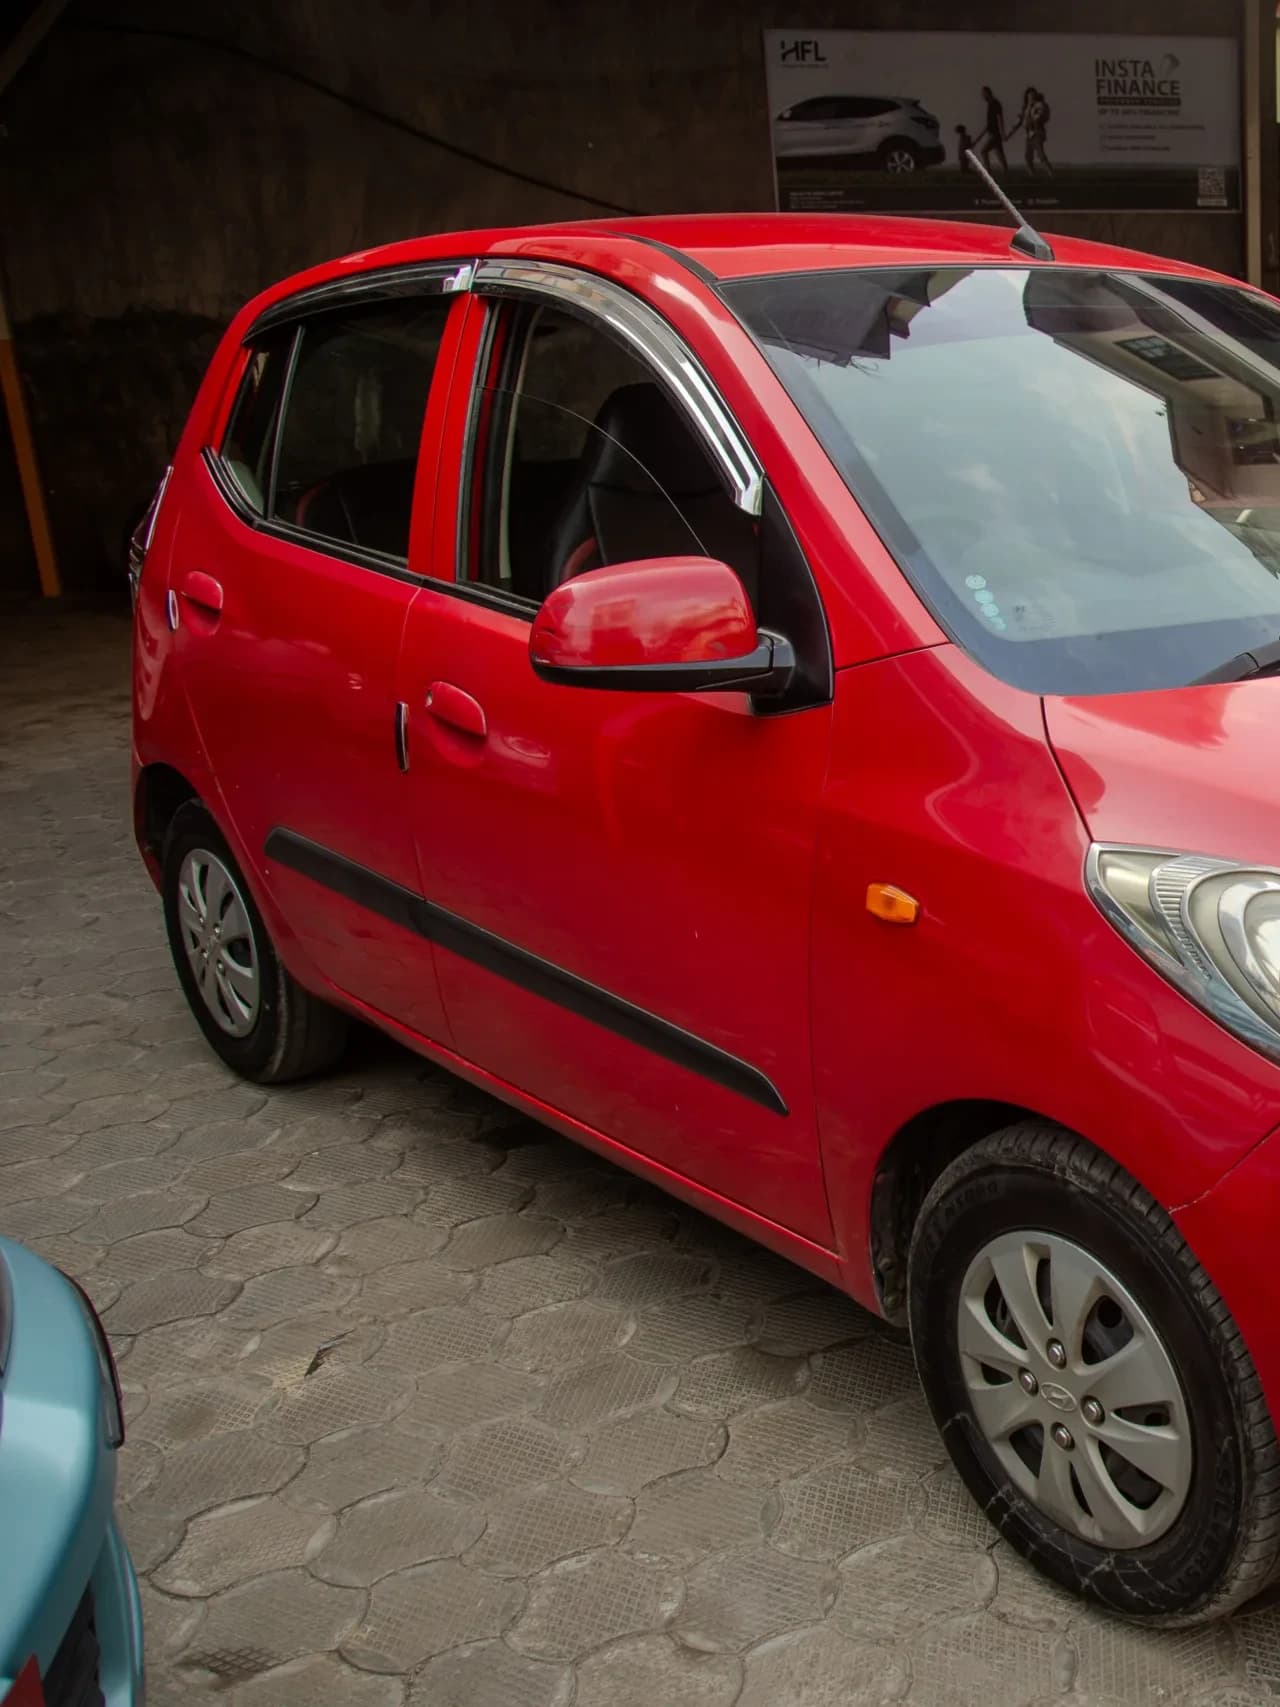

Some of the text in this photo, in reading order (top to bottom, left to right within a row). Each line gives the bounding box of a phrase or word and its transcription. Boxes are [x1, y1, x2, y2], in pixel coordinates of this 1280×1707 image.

[780, 39, 828, 63] HFL
[1095, 58, 1155, 78] INSTA
[1095, 78, 1182, 96] FINANCE
